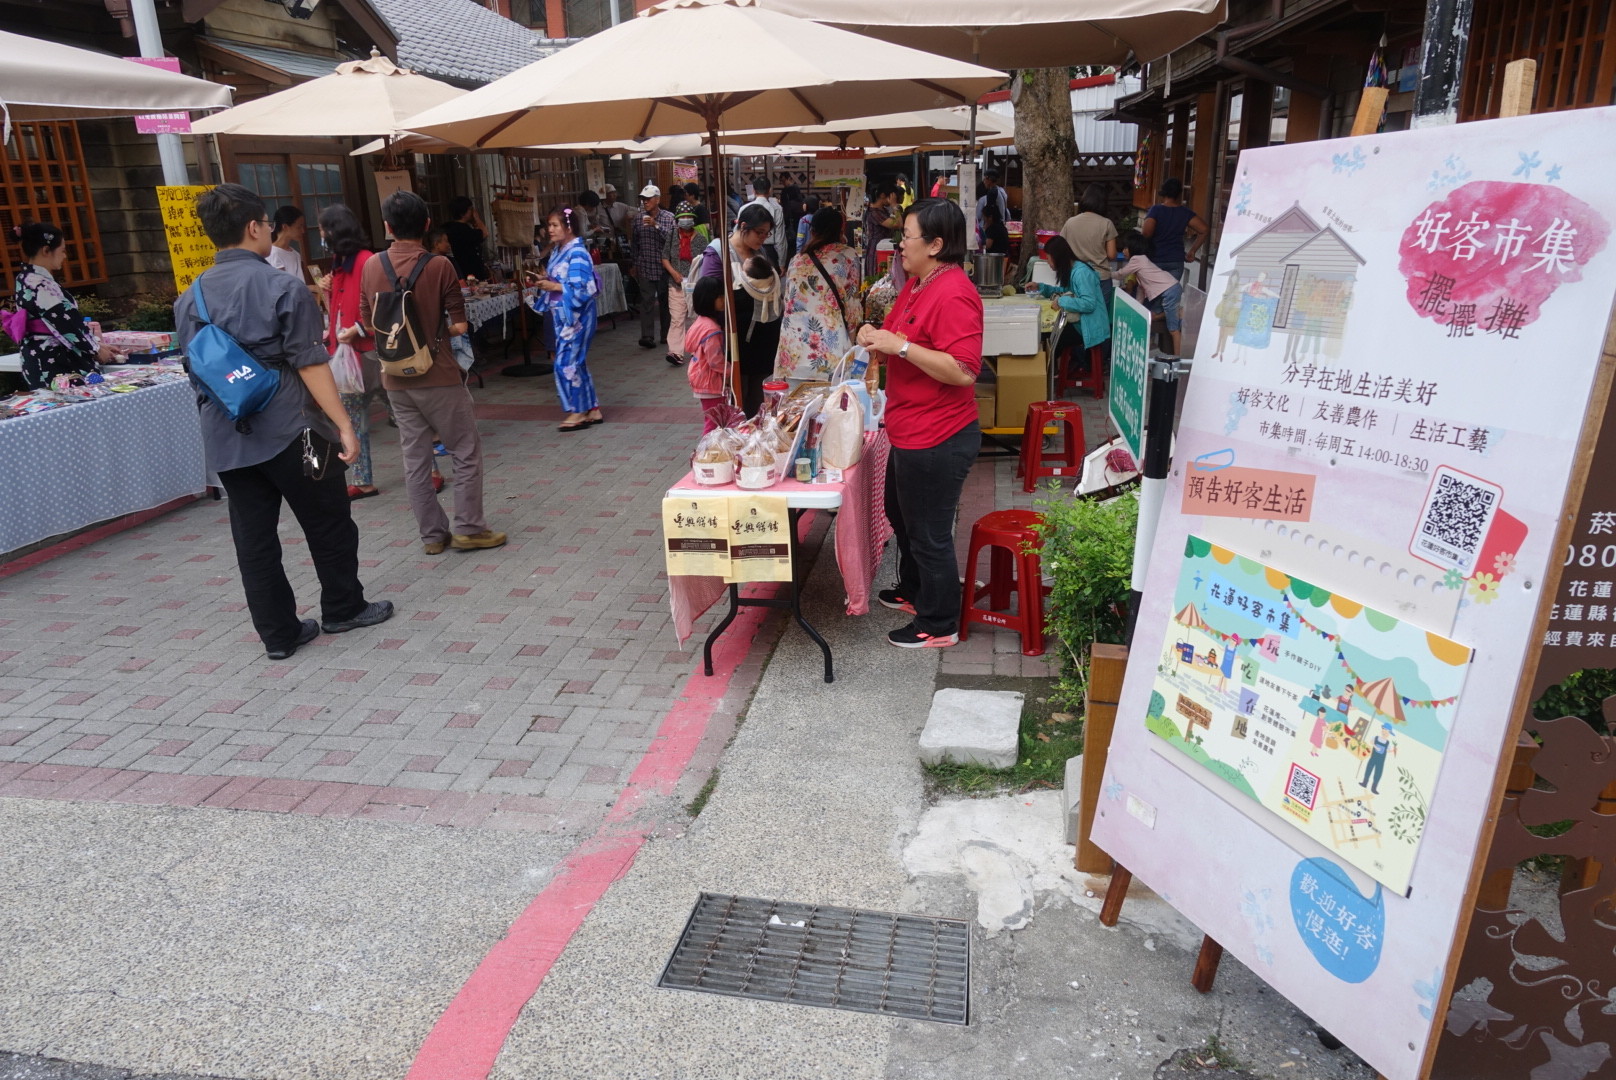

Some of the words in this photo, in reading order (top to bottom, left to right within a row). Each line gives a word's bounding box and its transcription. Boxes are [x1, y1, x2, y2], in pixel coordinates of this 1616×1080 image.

[1408, 208, 1577, 274] 好客市集
[1418, 270, 1530, 341] 擺擺攤
[225, 365, 253, 384] FILA
[1280, 361, 1438, 406] 分享在地生活美好
[1237, 386, 1290, 413] 好客文化
[1312, 400, 1379, 430] 友善農作
[1410, 417, 1490, 454] 生活工藝
[1356, 445, 1429, 473] 14:00-18:30
[1188, 475, 1307, 515] 預告好客生活
[1421, 539, 1459, 561] 花蓮好客市集
[1568, 580, 1613, 598] 花蓮
[982, 613, 1008, 626] 花蓮市公所
[1211, 583, 1291, 633] 花蓮好客市集
[1266, 639, 1280, 657] 玩
[1240, 662, 1253, 680] 吃
[1235, 719, 1248, 738] 地
[1299, 871, 1377, 950] 歡迎好客
